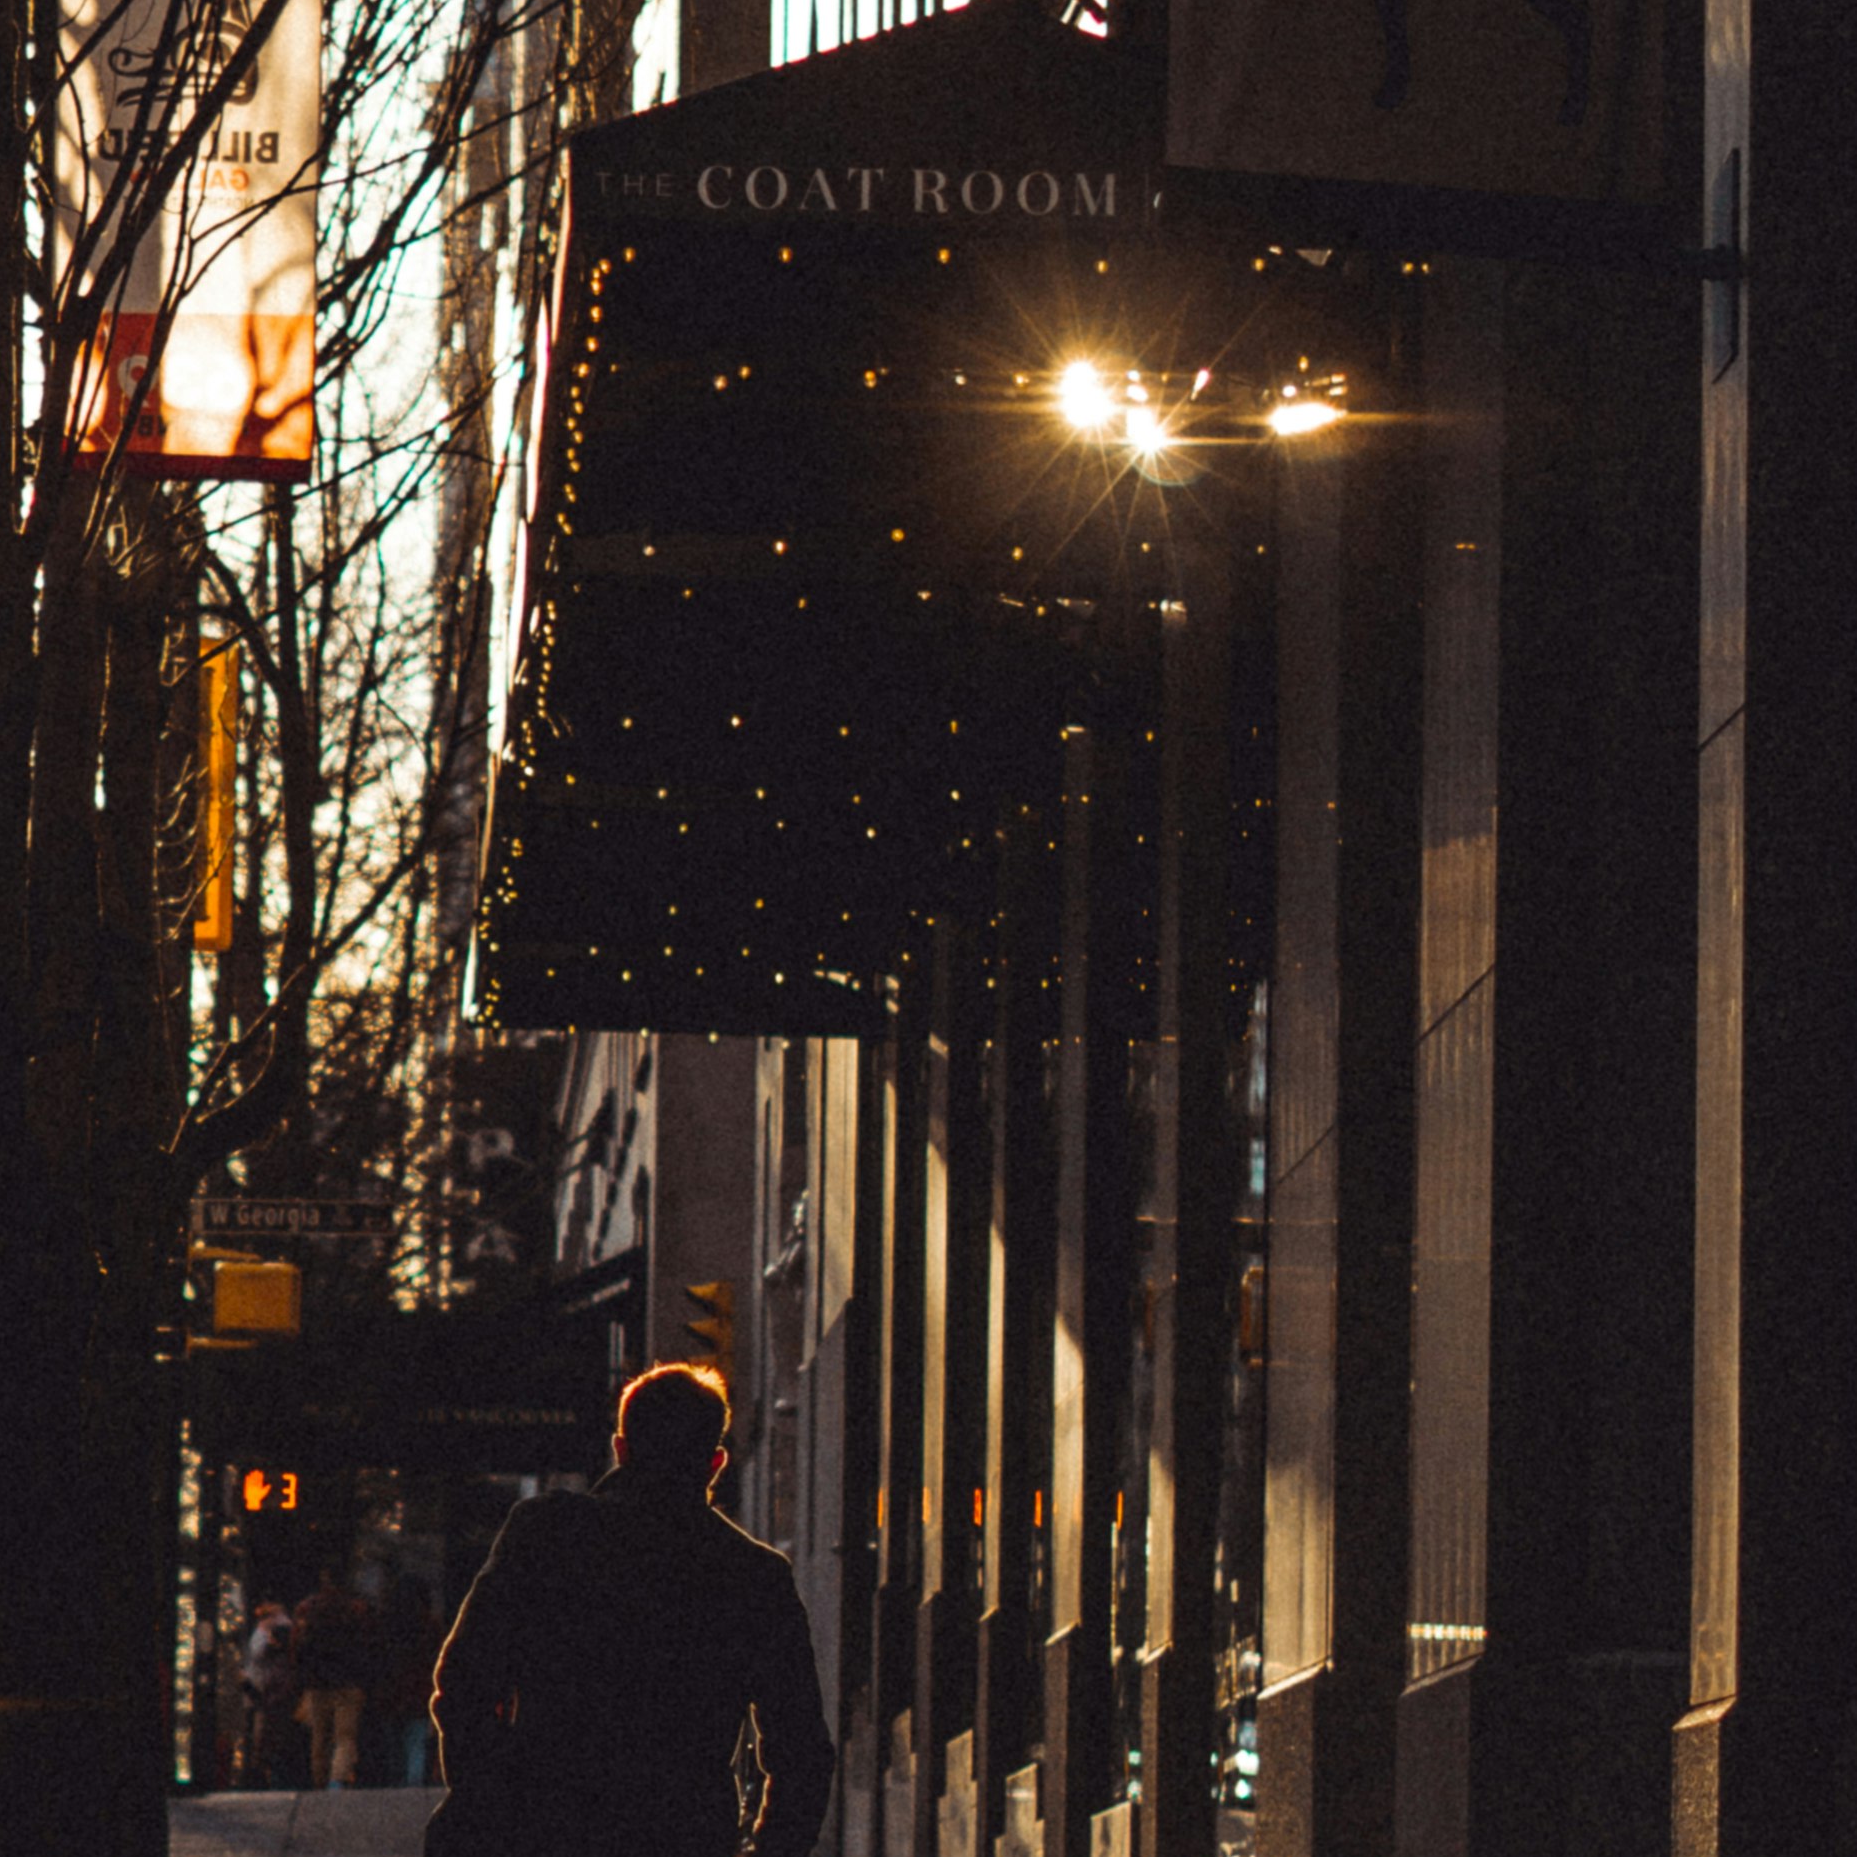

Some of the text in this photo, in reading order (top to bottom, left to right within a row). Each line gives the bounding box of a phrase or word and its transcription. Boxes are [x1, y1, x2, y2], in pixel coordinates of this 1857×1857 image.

[595, 163, 1118, 218] THE COAT ROOM
[209, 1204, 230, 1225] W
[236, 1204, 321, 1234] Georgia
[279, 1471, 299, 1511] 3
